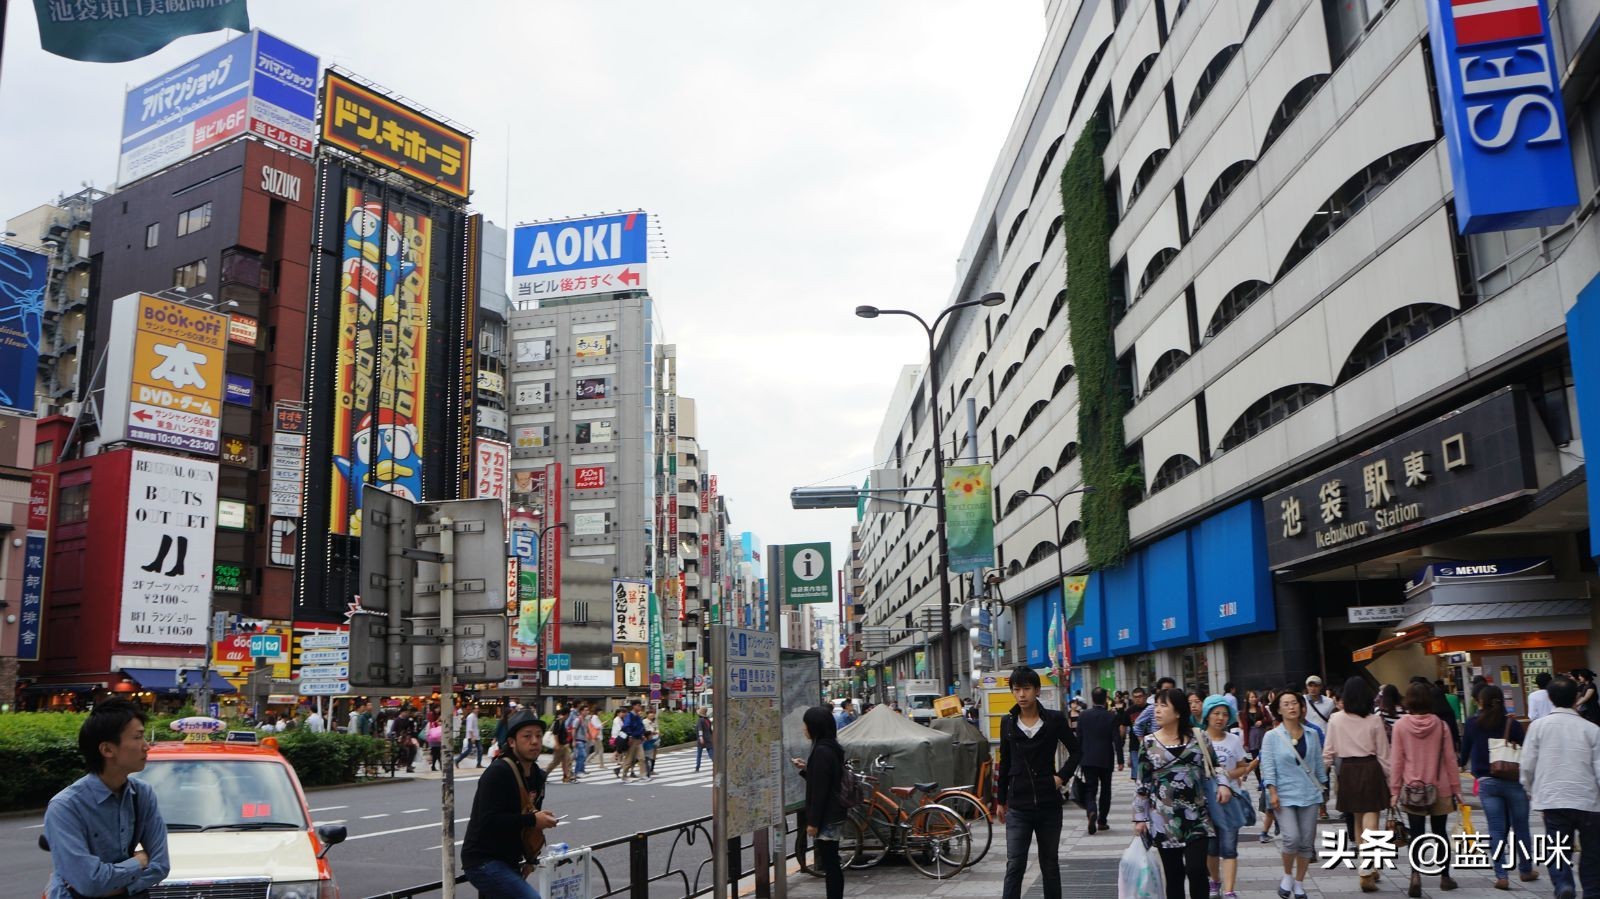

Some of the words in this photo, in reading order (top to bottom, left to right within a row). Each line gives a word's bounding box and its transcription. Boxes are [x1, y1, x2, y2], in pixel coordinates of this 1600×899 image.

[141, 54, 234, 122] アパマンショップ
[258, 55, 315, 89] アパマンショップ
[194, 108, 246, 145] 当ビル6F
[254, 120, 309, 151] 当ビル6F
[260, 165, 301, 202] SUZUKI
[526, 222, 623, 269] AOKI
[517, 273, 613, 296] 当ビル後方すぐ
[151, 342, 208, 389] 本
[1280, 432, 1468, 538] 池袋駅東口
[1316, 522, 1368, 549] Ikebukuro
[1375, 503, 1419, 531] Station
[1455, 564, 1498, 576] MEVIUS
[133, 623, 155, 635] ALL
[226, 651, 245, 660] au
